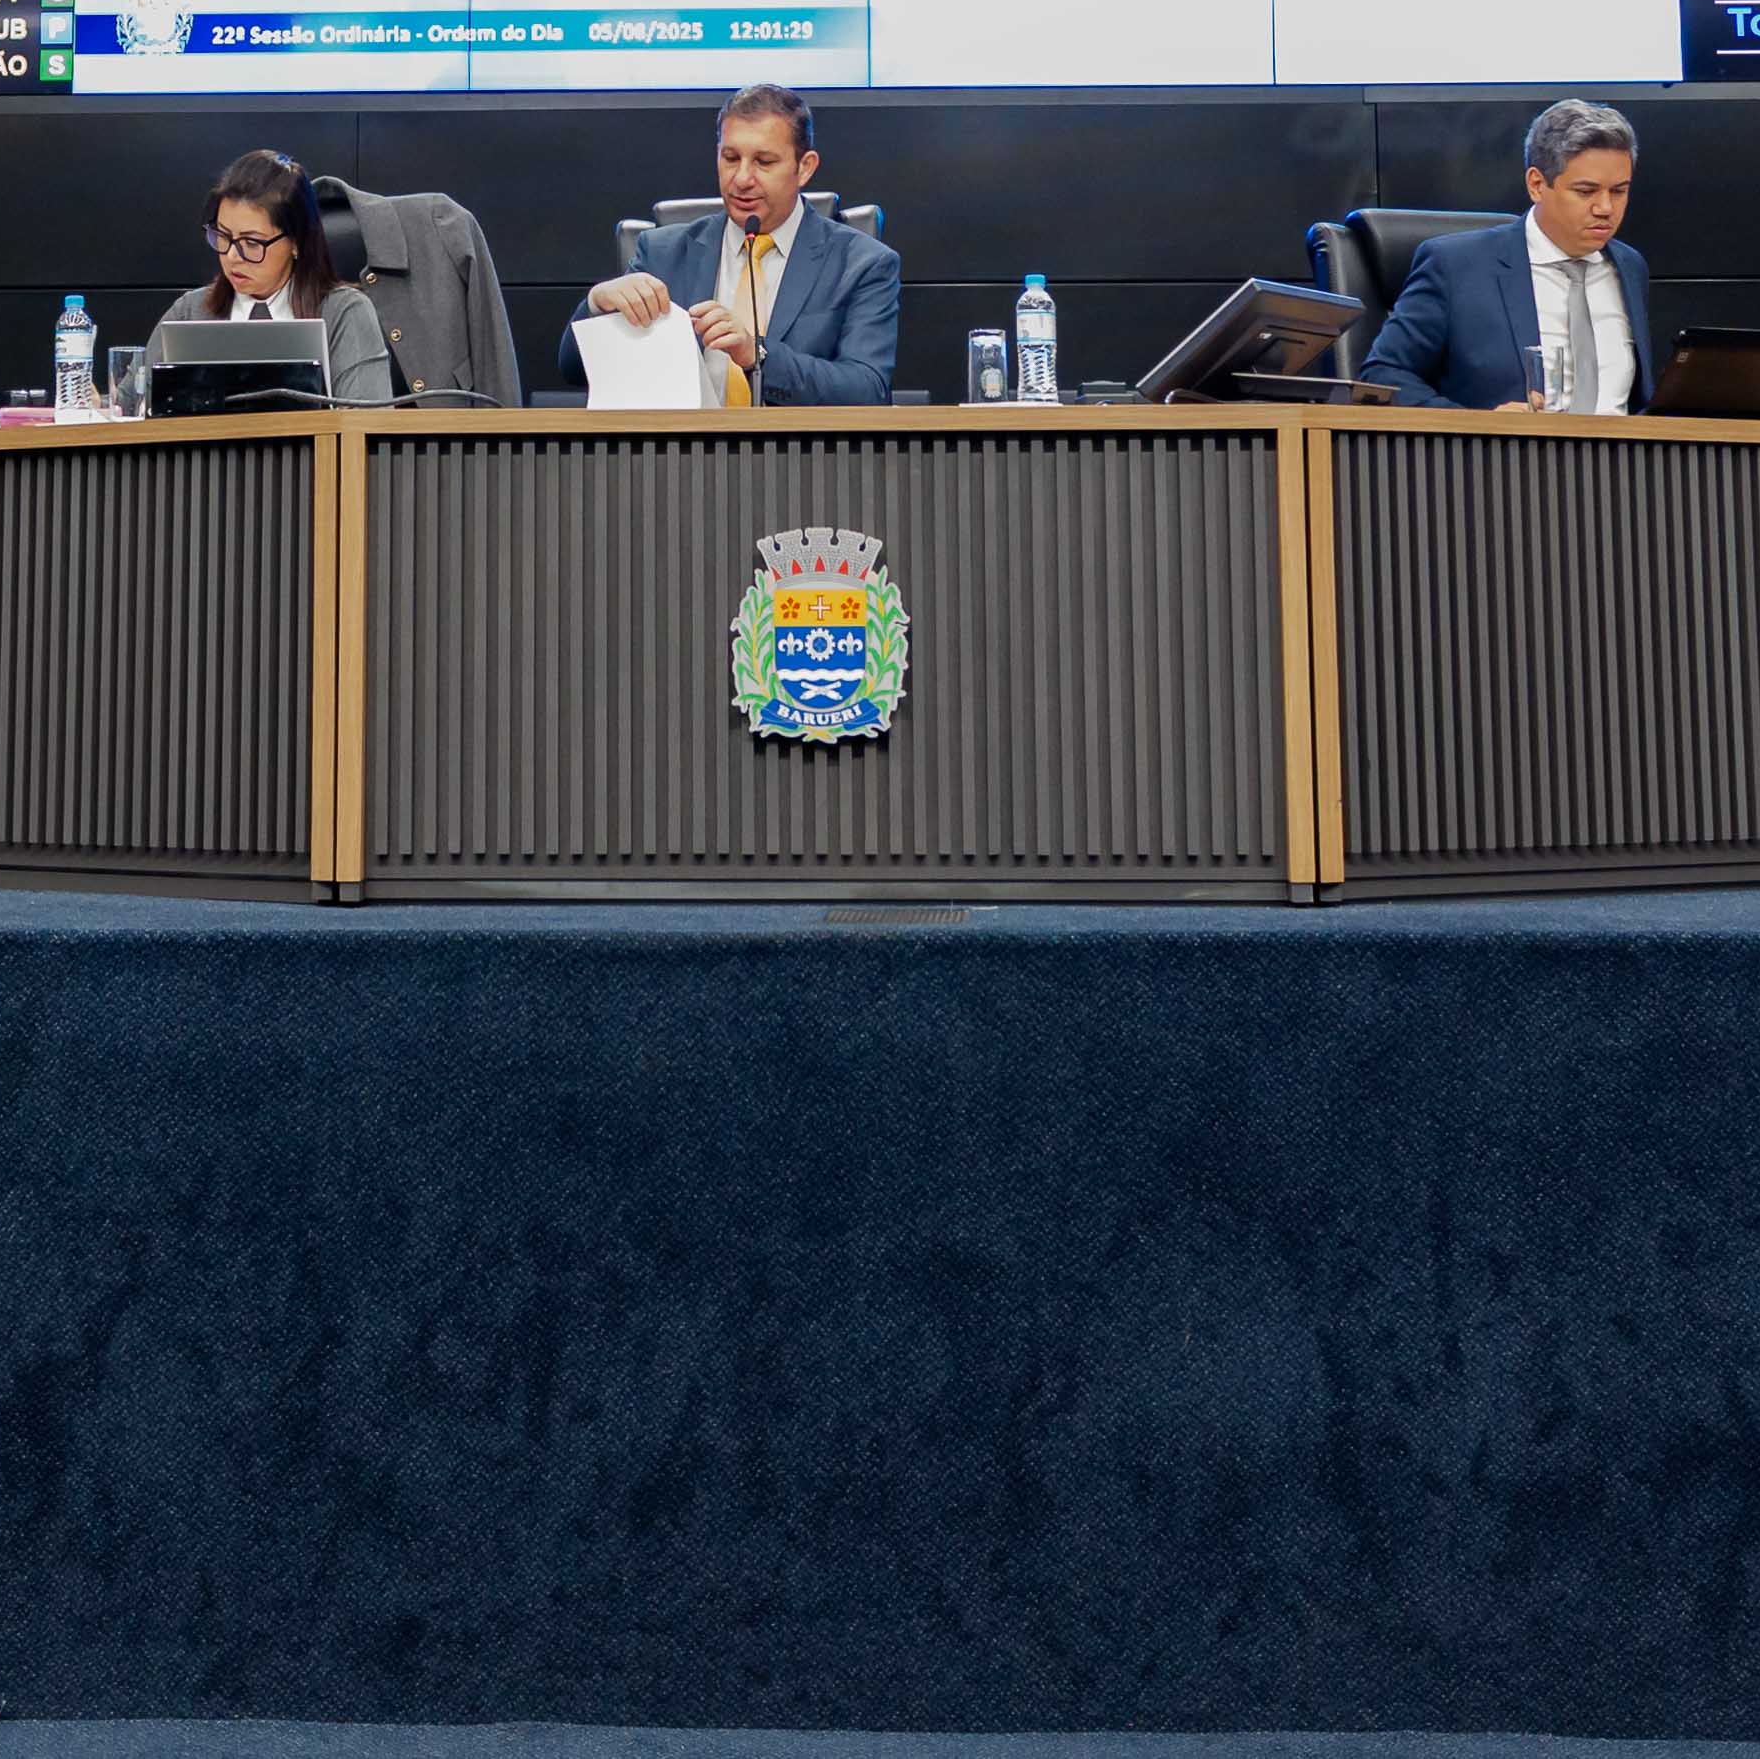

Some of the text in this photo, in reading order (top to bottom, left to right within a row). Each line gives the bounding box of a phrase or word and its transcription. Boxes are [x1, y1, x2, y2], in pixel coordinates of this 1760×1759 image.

[50, 19, 66, 38] P
[250, 25, 315, 44] Sessão
[320, 25, 411, 43] Ordinária
[501, 25, 526, 40] do
[531, 24, 563, 40] Dia
[49, 56, 65, 75] S
[776, 704, 863, 725] BARUERI
